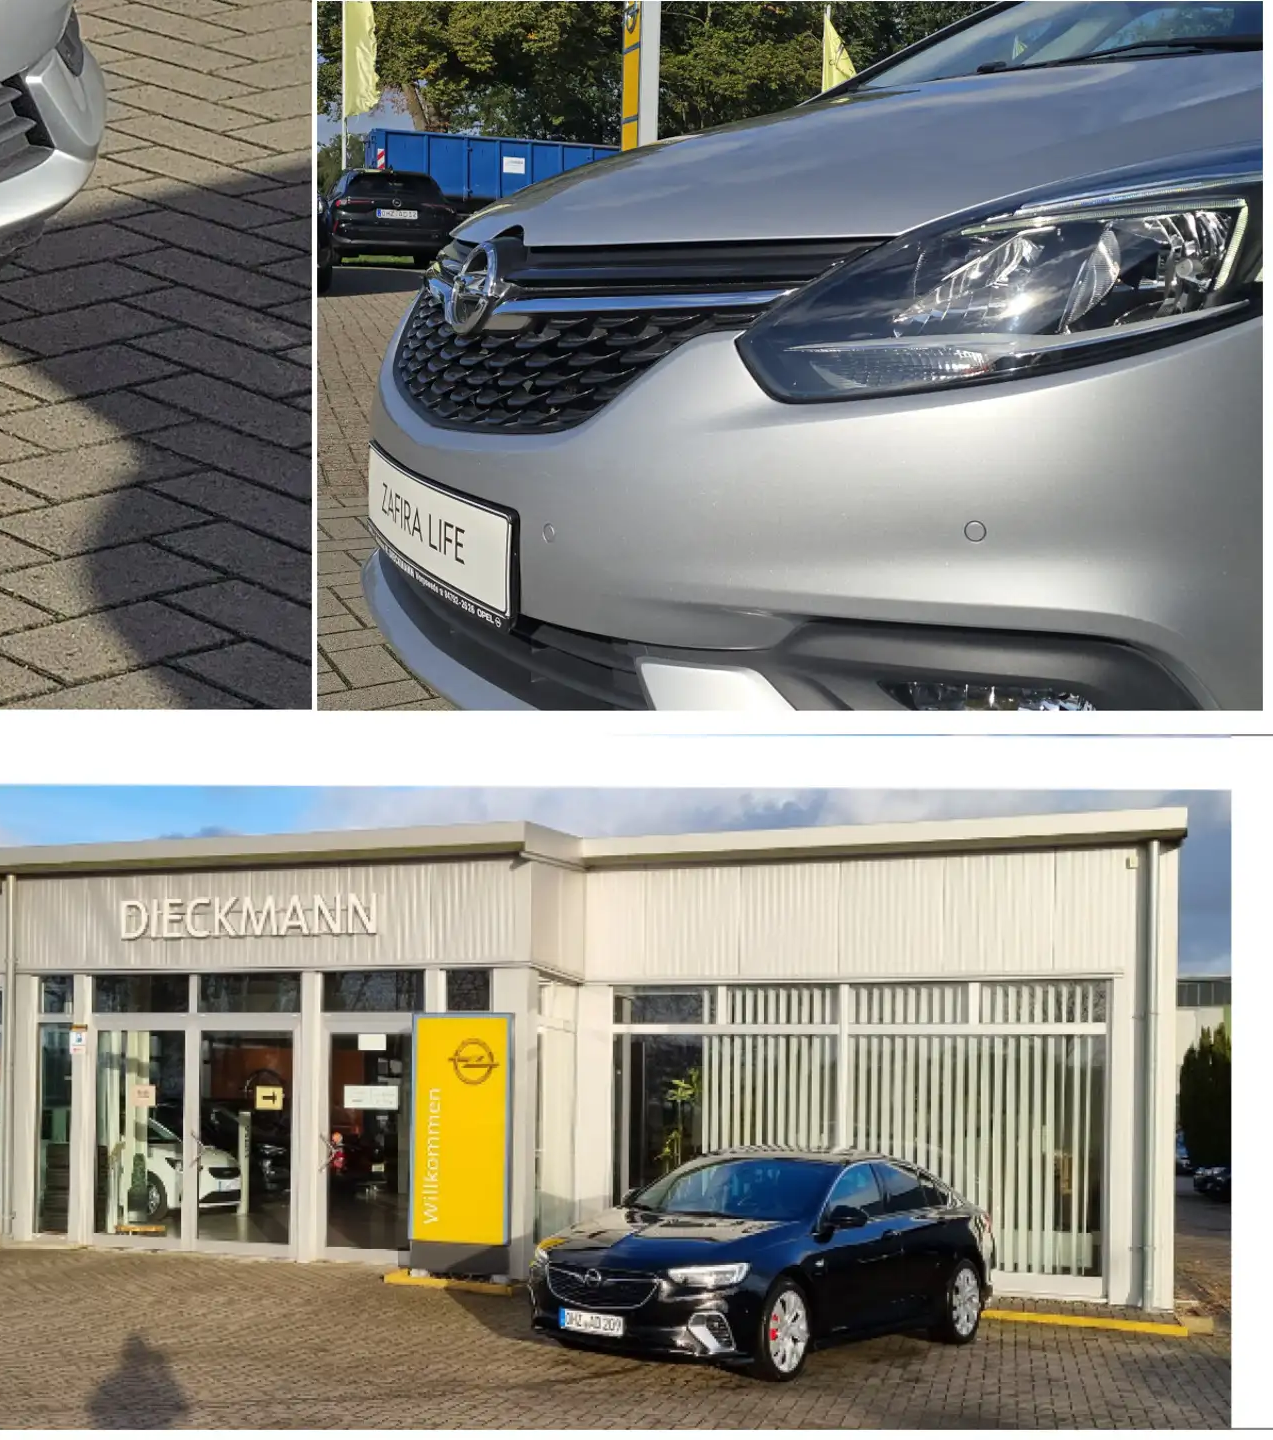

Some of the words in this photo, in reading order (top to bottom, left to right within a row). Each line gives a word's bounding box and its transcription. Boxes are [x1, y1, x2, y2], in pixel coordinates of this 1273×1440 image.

[381, 482, 423, 543] ZAFIRA
[428, 513, 466, 565] LIFE
[476, 608, 495, 625] OPEL
[120, 893, 377, 941] DIECKMANN
[422, 1087, 442, 1226] Willkommen
